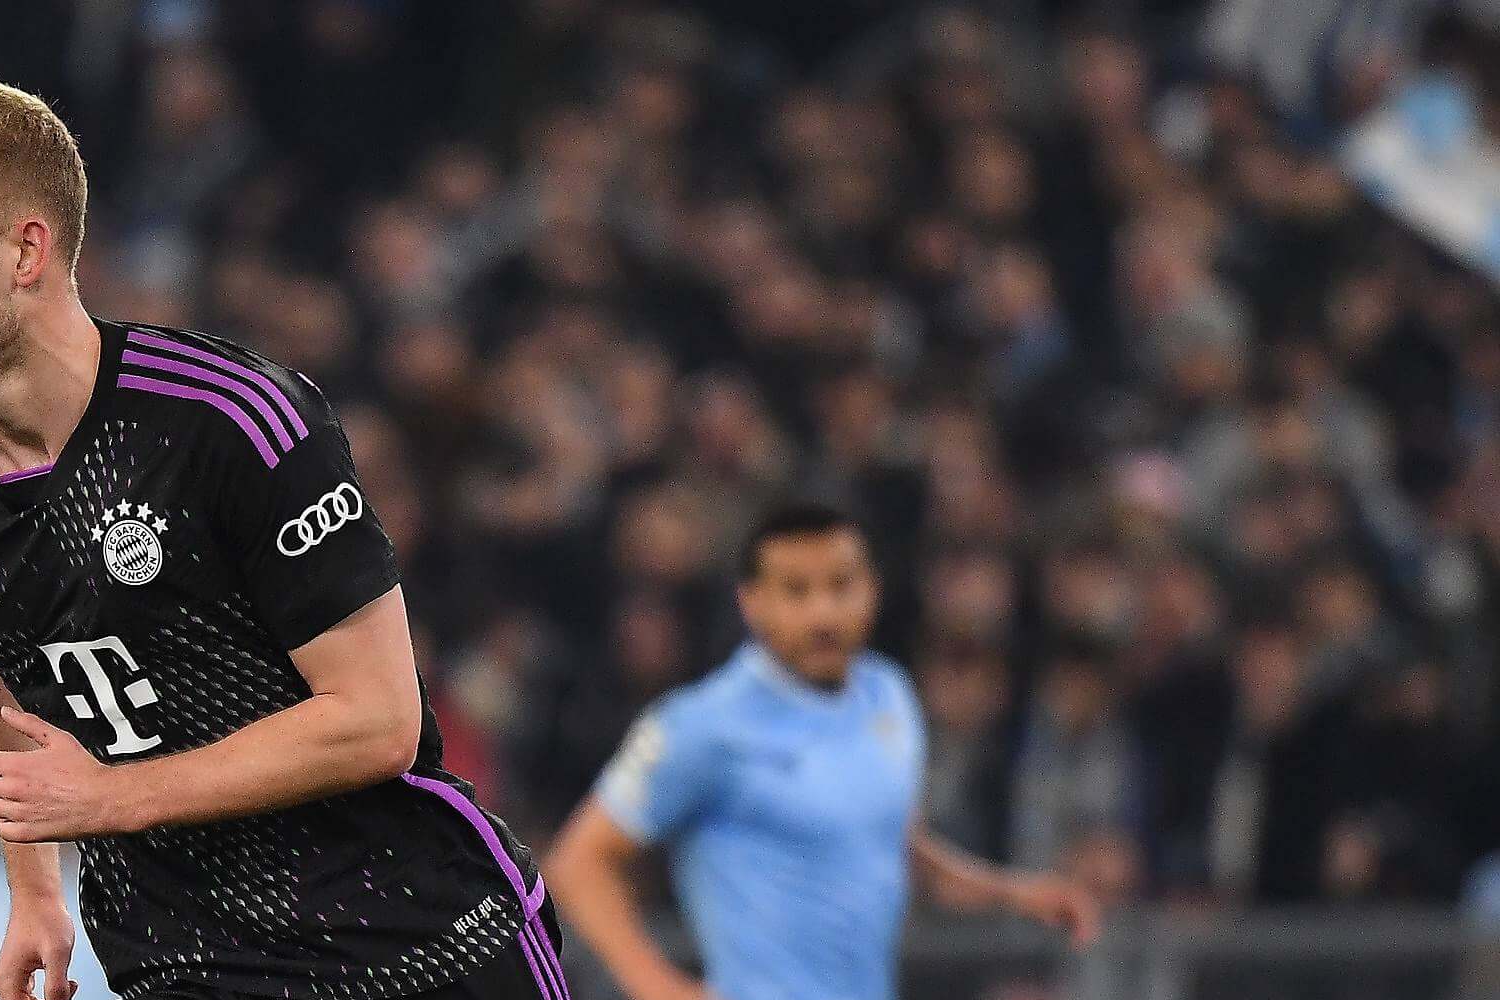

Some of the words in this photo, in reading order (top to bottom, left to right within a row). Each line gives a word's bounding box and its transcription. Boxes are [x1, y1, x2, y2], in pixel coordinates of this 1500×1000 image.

[107, 536, 117, 551] FC
[115, 525, 154, 546] BAYERN
[37, 635, 162, 755] T
